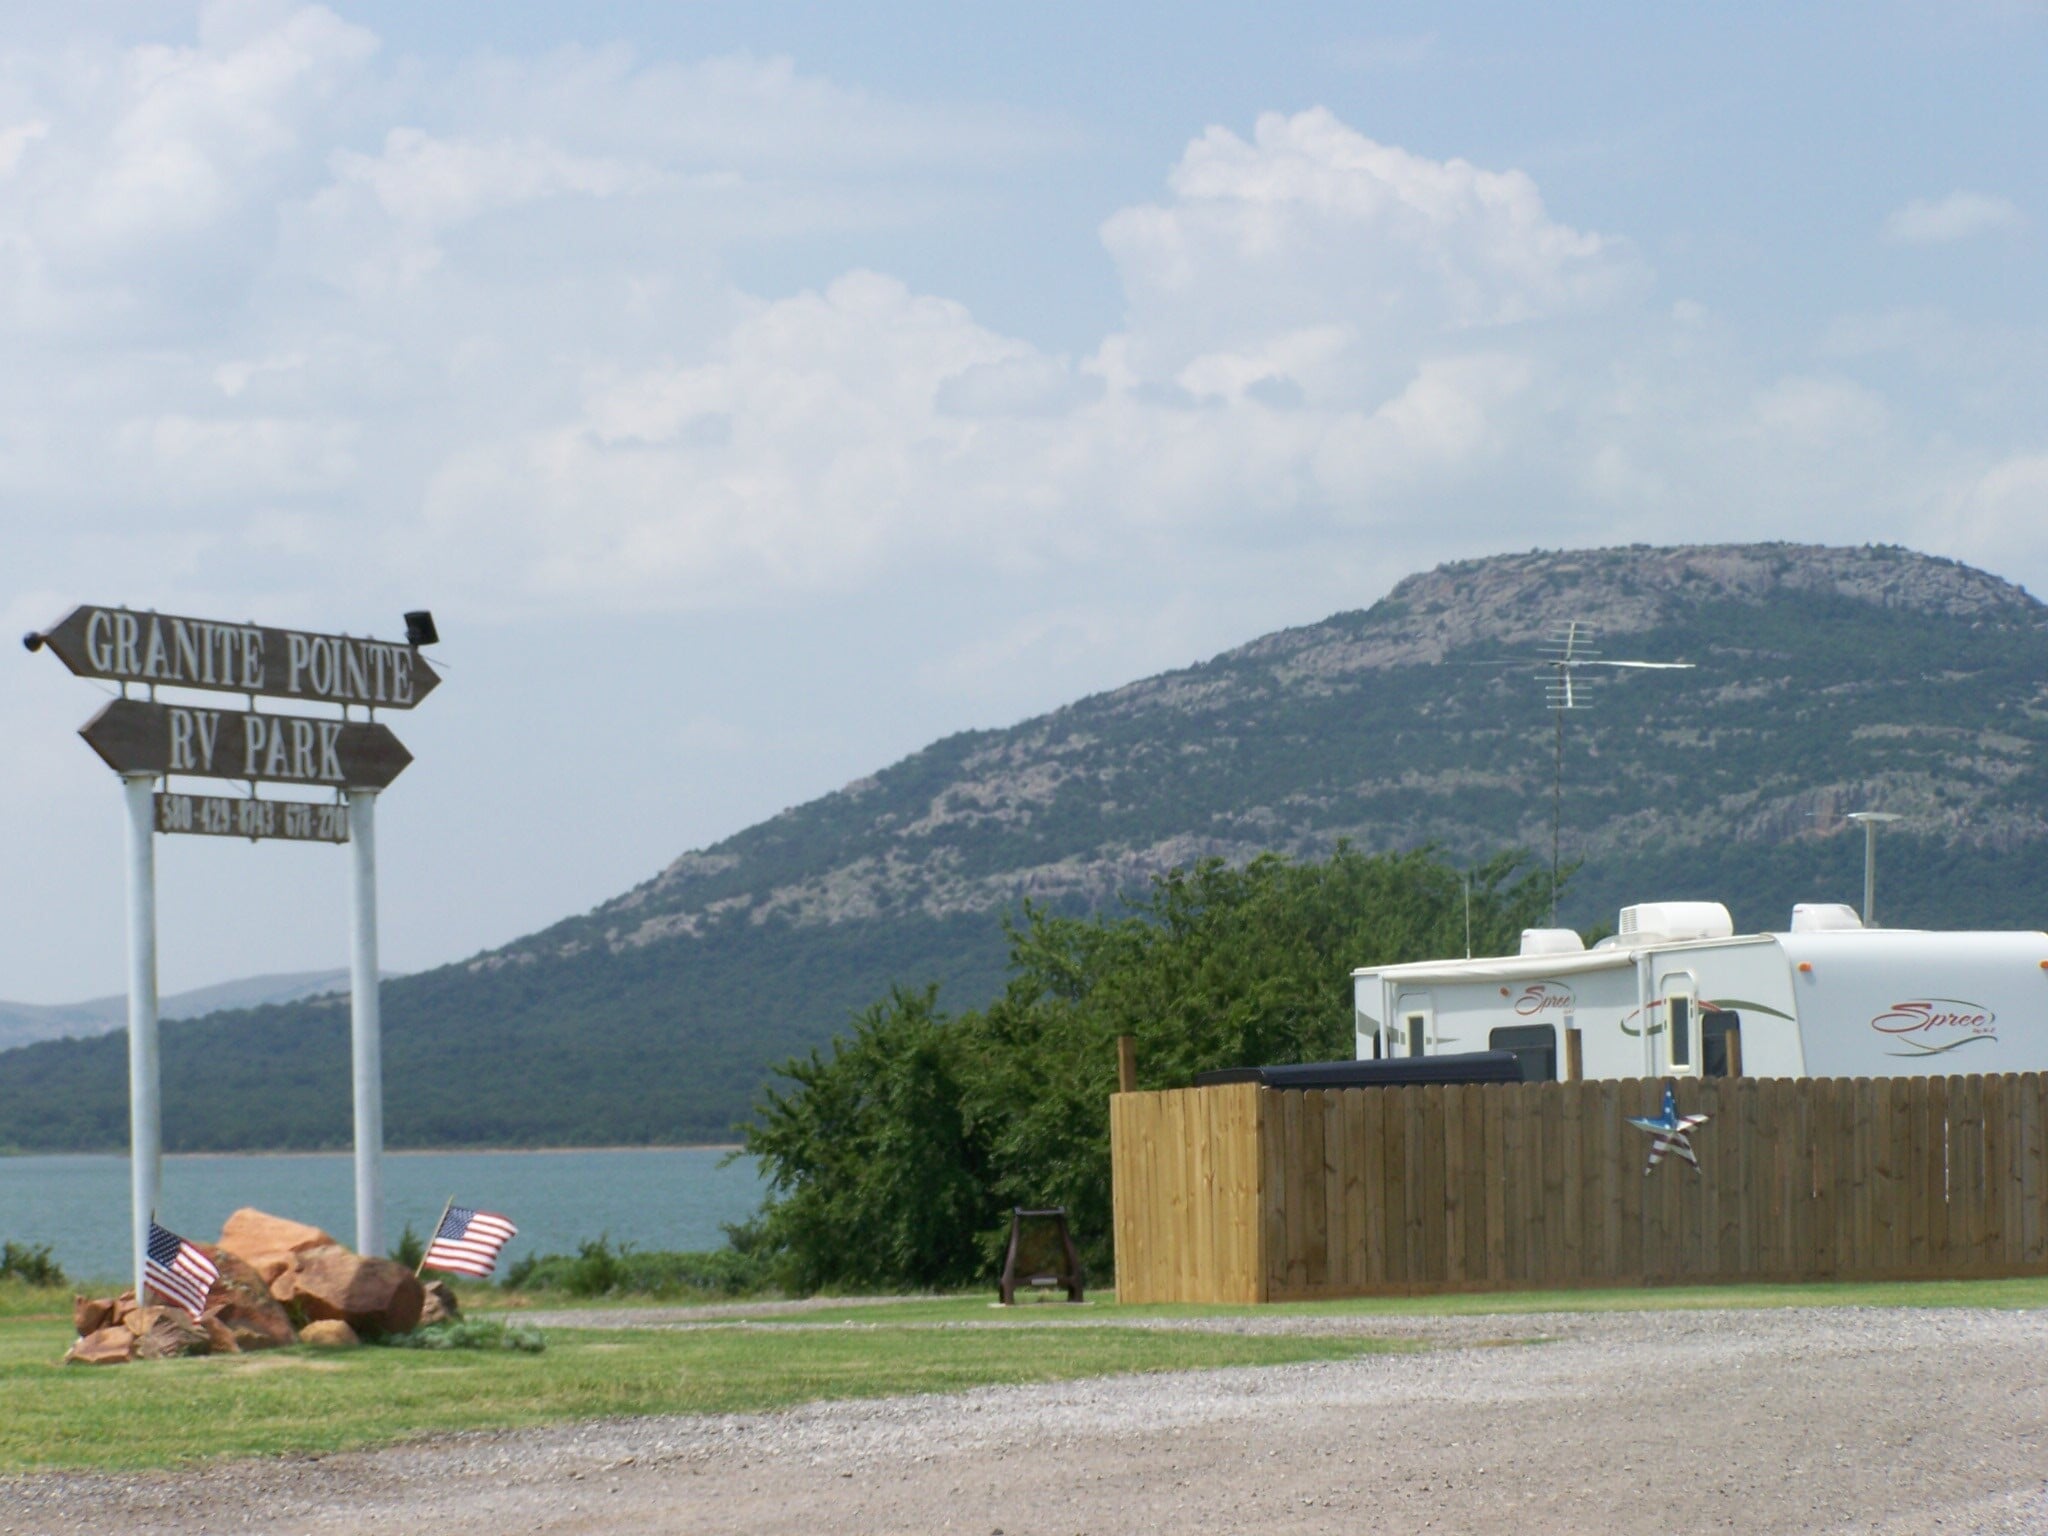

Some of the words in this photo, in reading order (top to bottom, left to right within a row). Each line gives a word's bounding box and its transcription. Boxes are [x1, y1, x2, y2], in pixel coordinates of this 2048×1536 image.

[86, 611, 266, 690] GRANITE
[287, 634, 414, 705] POINTE
[170, 709, 220, 771] RV
[243, 715, 345, 781] PARK
[1515, 985, 1570, 1016] Spree
[1872, 1003, 1985, 1033] Spree
